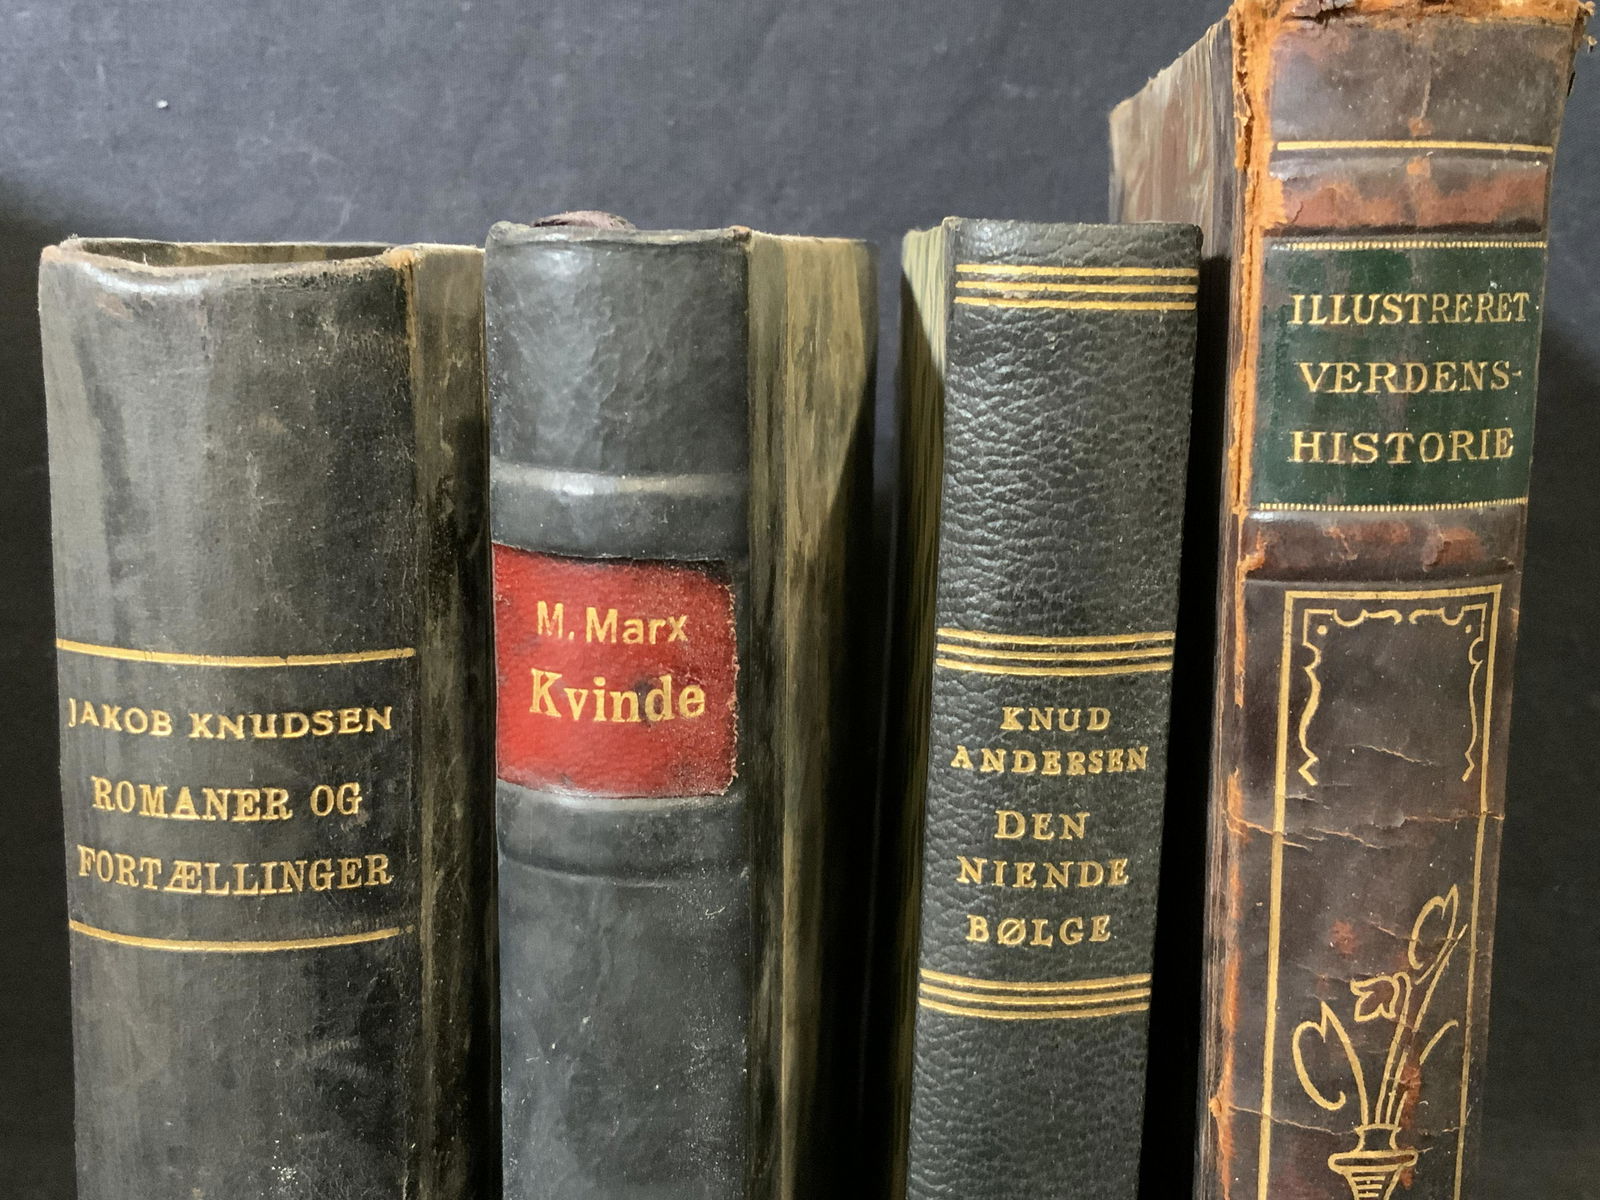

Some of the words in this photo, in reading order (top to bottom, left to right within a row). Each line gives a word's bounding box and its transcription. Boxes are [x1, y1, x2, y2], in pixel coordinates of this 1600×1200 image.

[1287, 292, 1530, 325] ILLUSTRERET
[1287, 427, 1514, 465] HISTORIE
[537, 601, 575, 640] M.
[585, 606, 688, 645] Marx
[529, 668, 706, 723] Kvinde
[68, 698, 173, 736] JAKOB
[188, 706, 393, 740] KNUDSEN
[1000, 706, 1112, 732] KNUD
[950, 745, 1149, 775] ANDERSEN
[90, 776, 293, 821] ROMANER
[309, 782, 363, 817] OG
[993, 810, 1091, 840] DEN
[77, 844, 394, 896] FORTÆLLINGER
[955, 856, 1130, 888] NIENDE
[965, 914, 1112, 946] BØLGE
